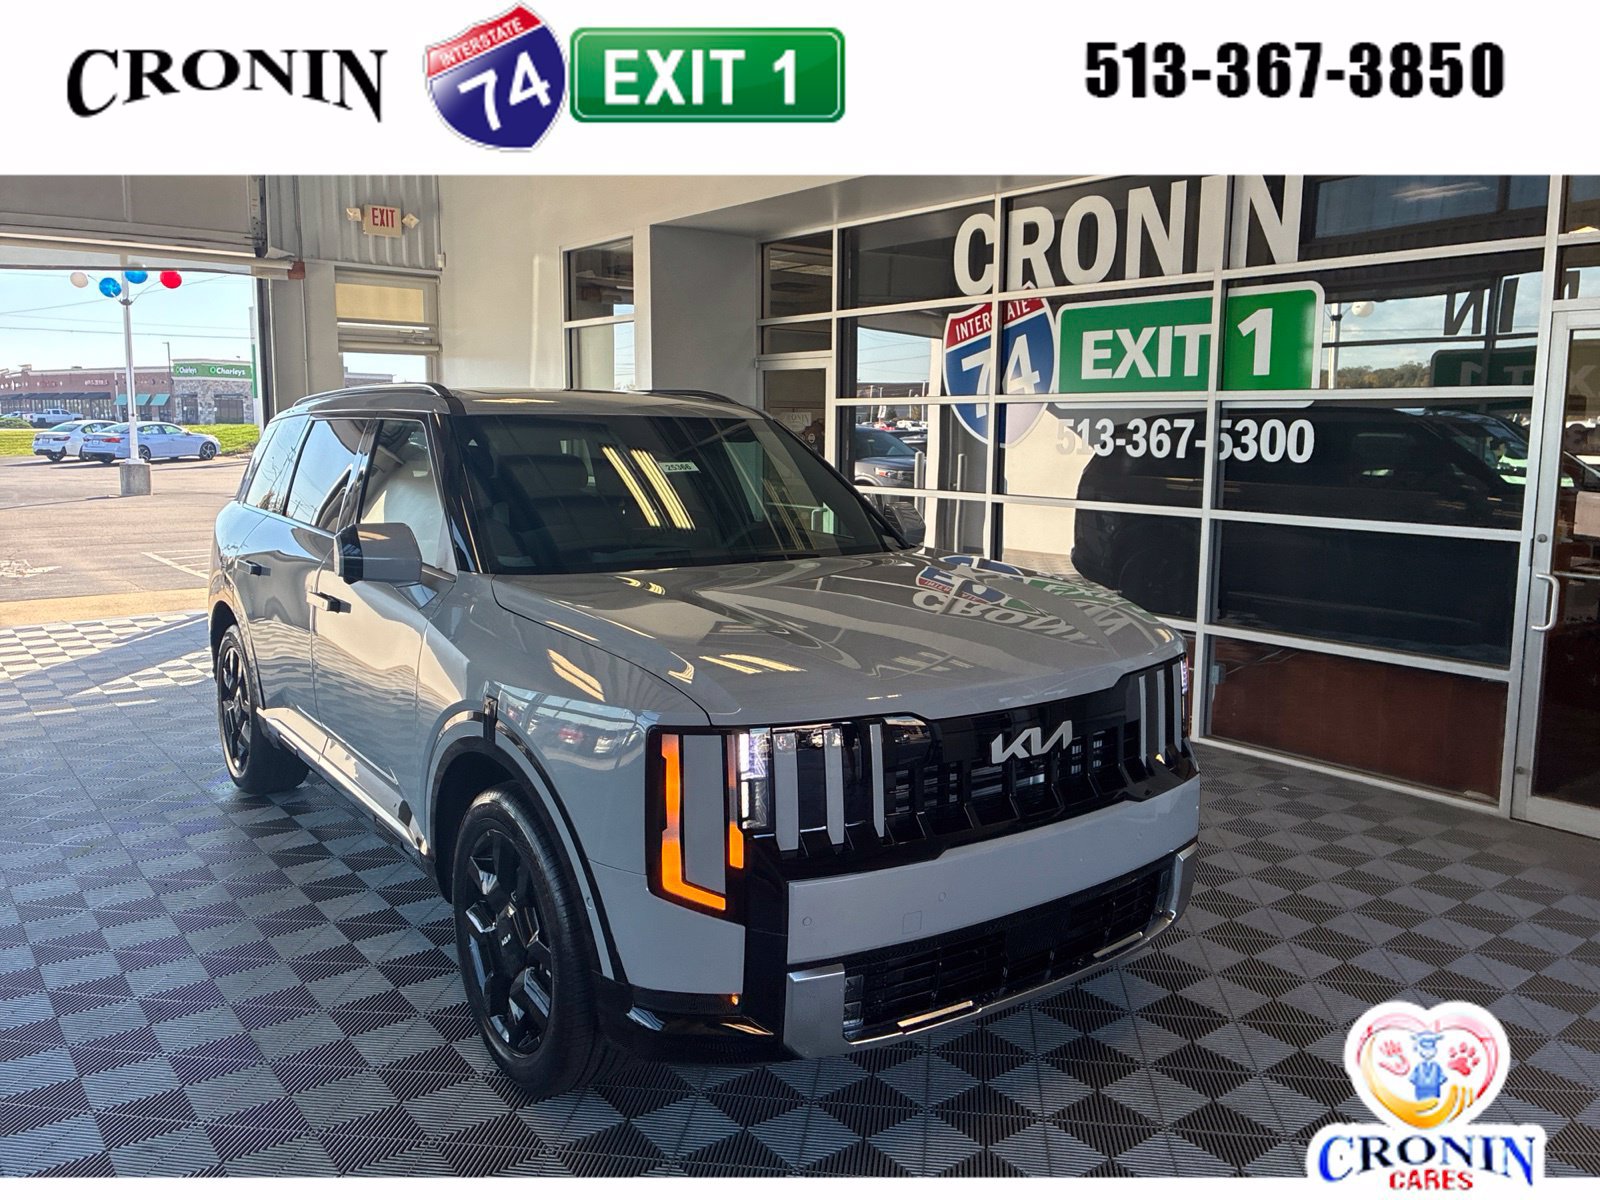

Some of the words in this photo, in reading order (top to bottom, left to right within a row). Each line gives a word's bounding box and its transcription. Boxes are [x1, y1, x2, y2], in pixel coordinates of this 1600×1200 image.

[371, 207, 395, 228] EXIT
[953, 174, 1303, 296] CRONIN
[1081, 323, 1212, 381] EXIT
[1237, 307, 1273, 376] 1
[217, 367, 246, 376] Charleys
[1056, 418, 1315, 463] 513-367-5300
[991, 720, 1073, 764] KIA
